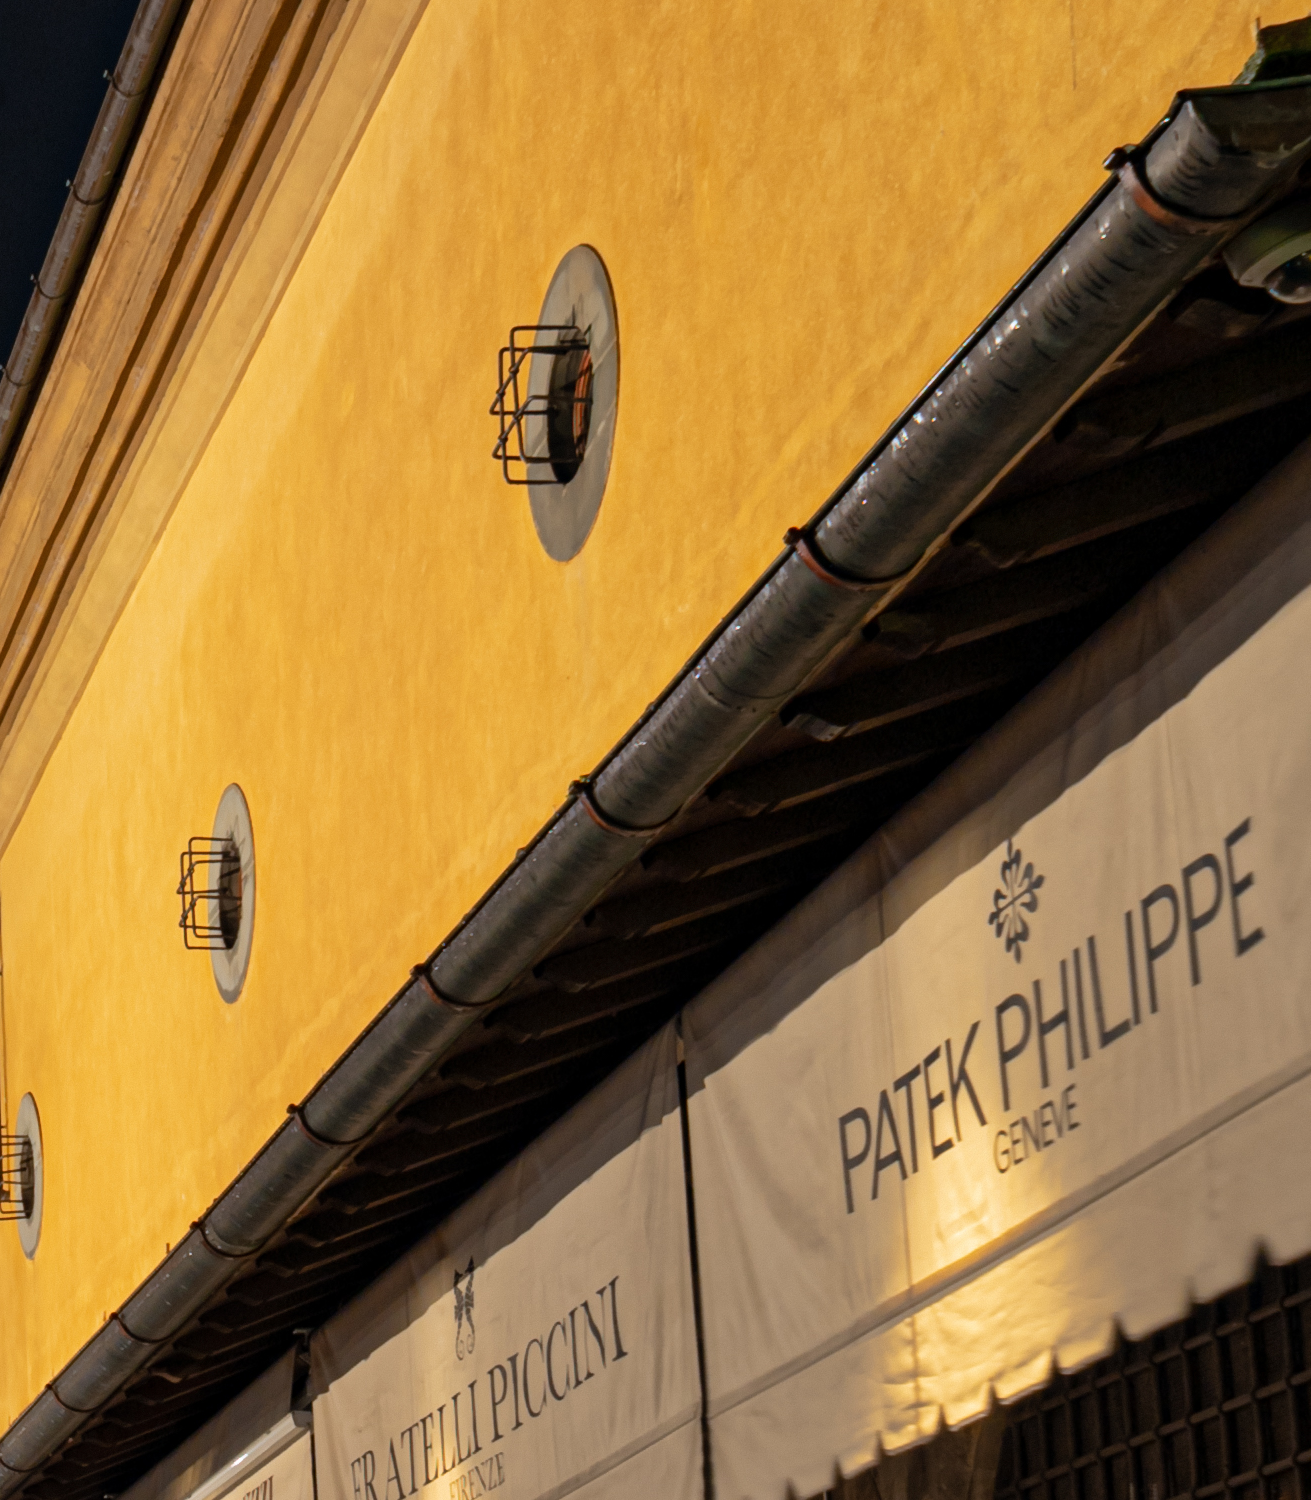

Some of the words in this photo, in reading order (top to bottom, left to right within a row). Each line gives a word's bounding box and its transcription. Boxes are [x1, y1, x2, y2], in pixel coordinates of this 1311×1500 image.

[837, 1020, 989, 1215] PATEK
[994, 815, 1266, 1113] PHILIPPE
[992, 1082, 1081, 1174] GENEVE
[486, 1274, 629, 1445] PICCINI
